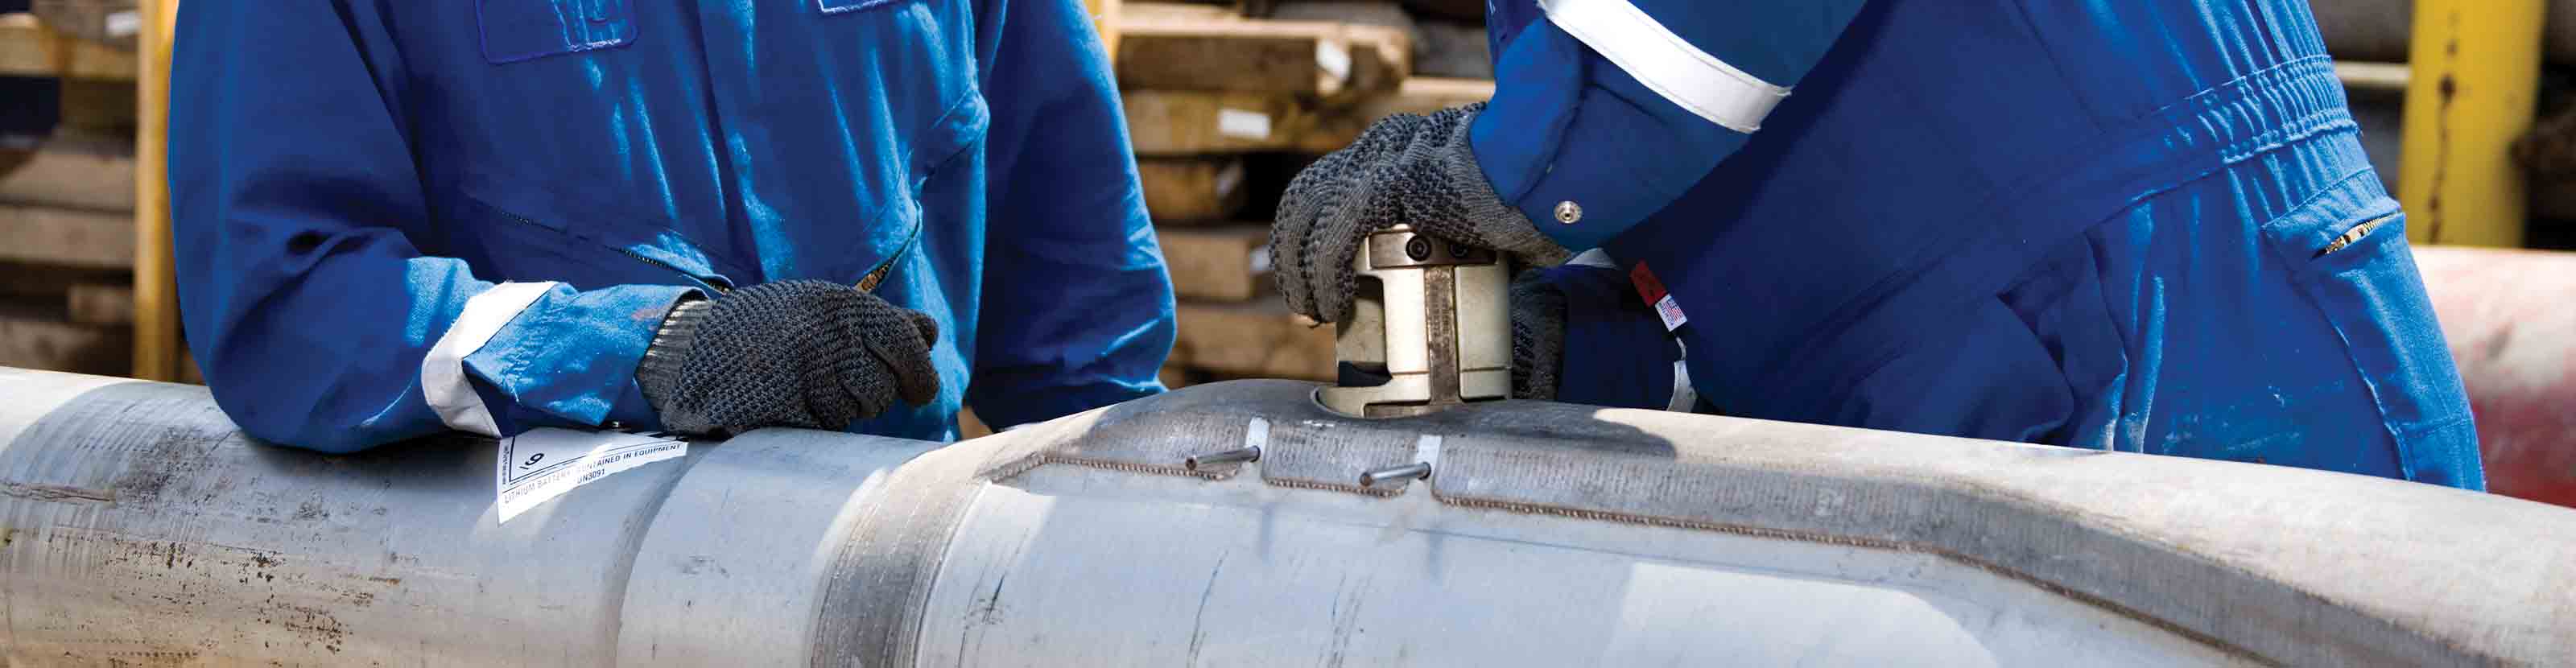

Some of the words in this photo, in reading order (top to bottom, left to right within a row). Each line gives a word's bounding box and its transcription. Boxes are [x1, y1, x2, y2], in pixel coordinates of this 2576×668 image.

[504, 484, 535, 504] LITHIUM
[537, 469, 571, 489] BATTERY
[576, 455, 621, 473] ONTAINED
[634, 443, 681, 457] EQUIPMENT
[577, 468, 605, 485] UN3091
